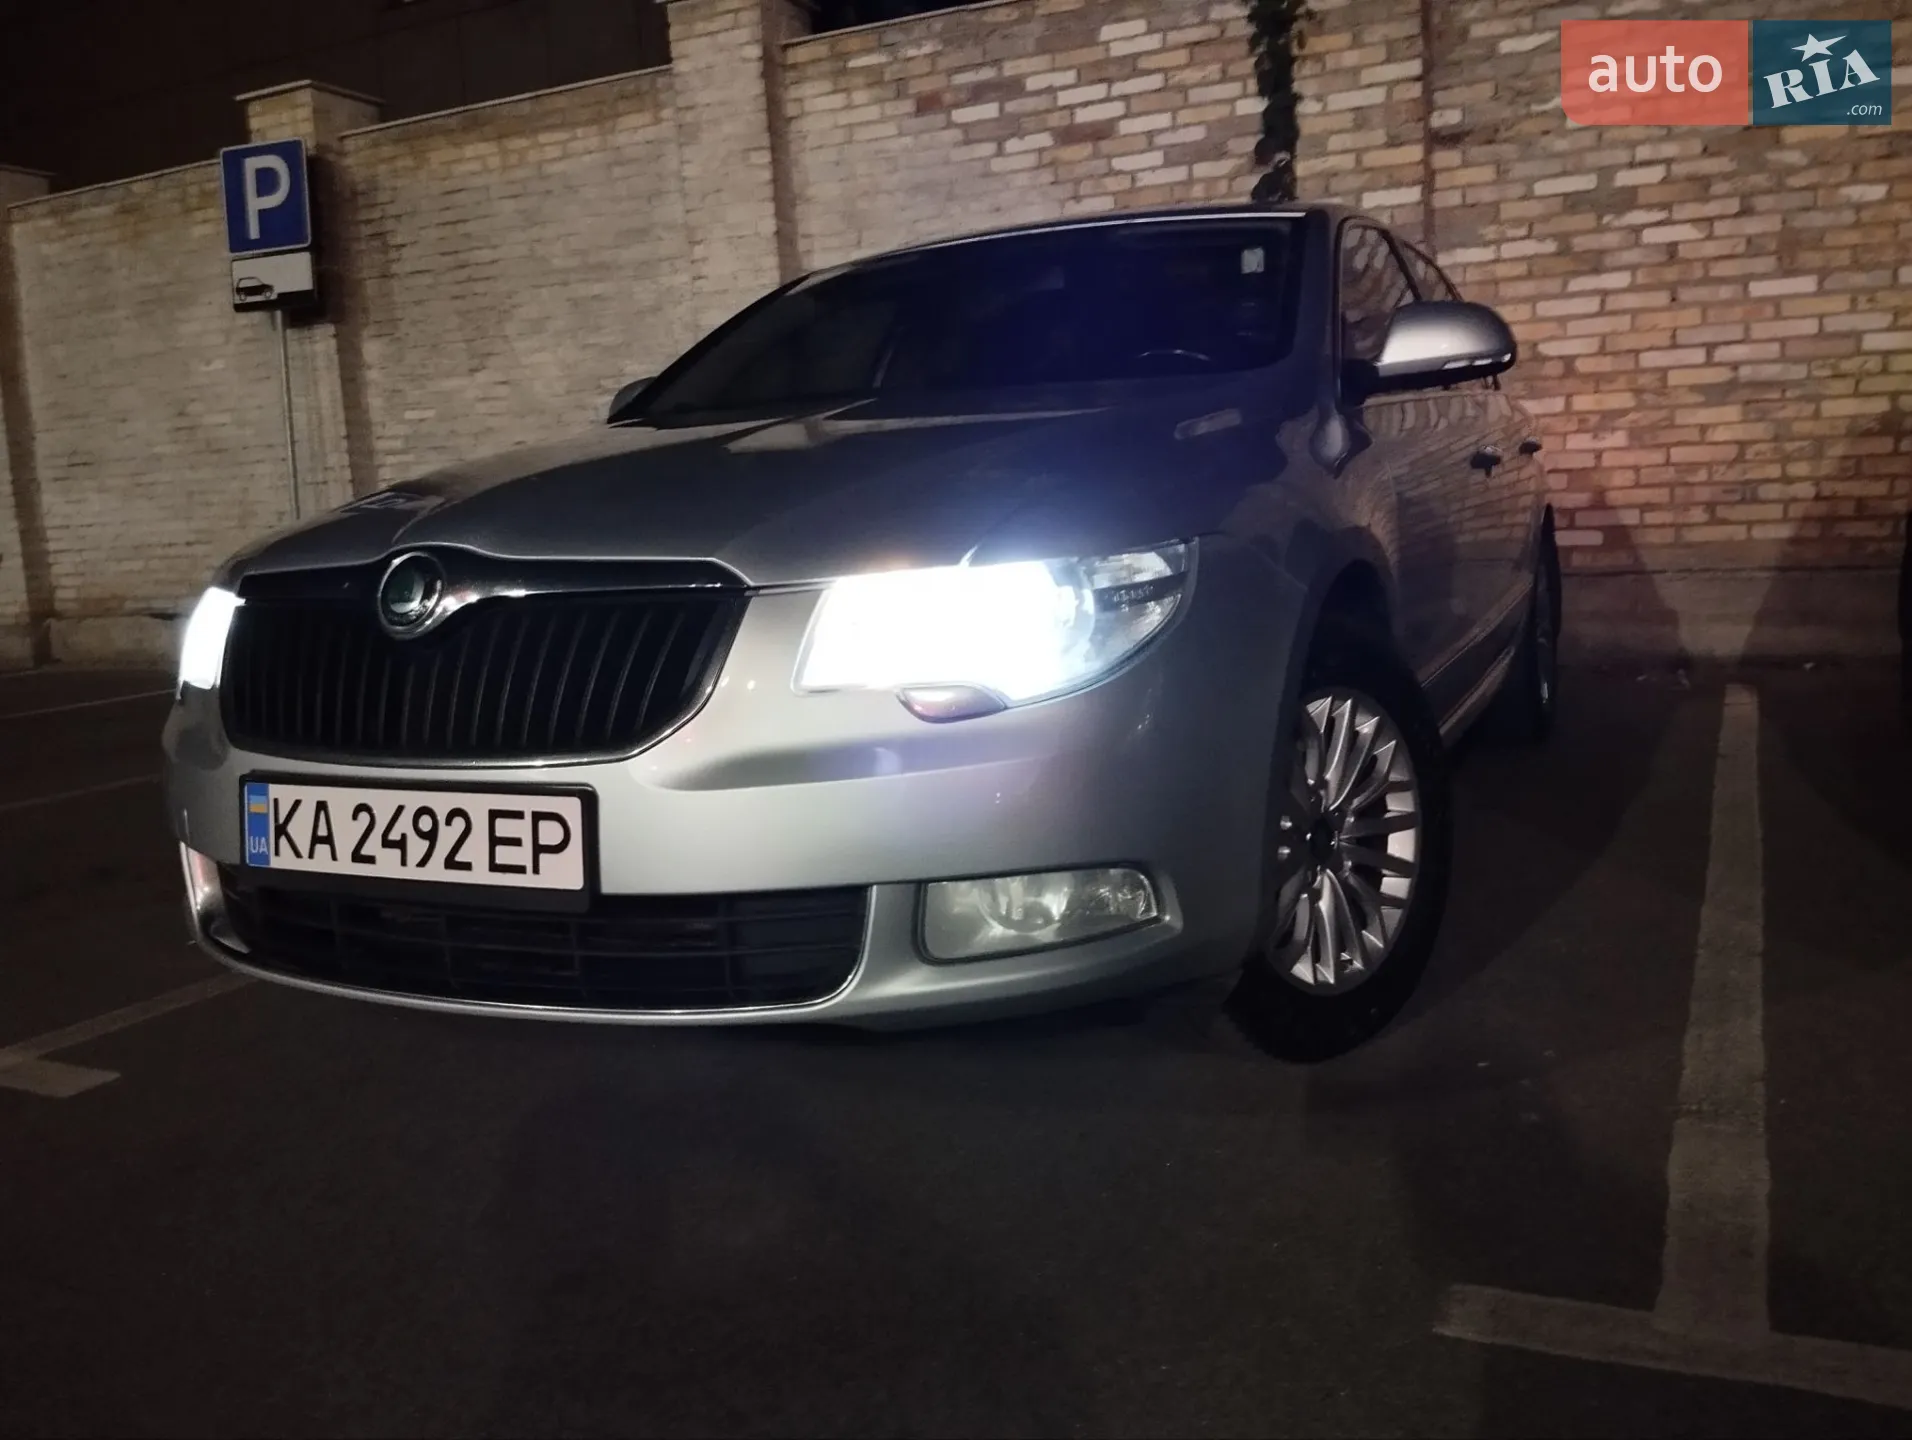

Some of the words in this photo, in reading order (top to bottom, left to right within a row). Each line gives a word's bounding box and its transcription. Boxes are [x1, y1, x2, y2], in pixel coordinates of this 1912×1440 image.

[244, 154, 290, 239] P
[250, 836, 268, 855] UA
[273, 797, 338, 861] KA
[350, 803, 473, 871] 2492
[488, 808, 572, 875] EP
